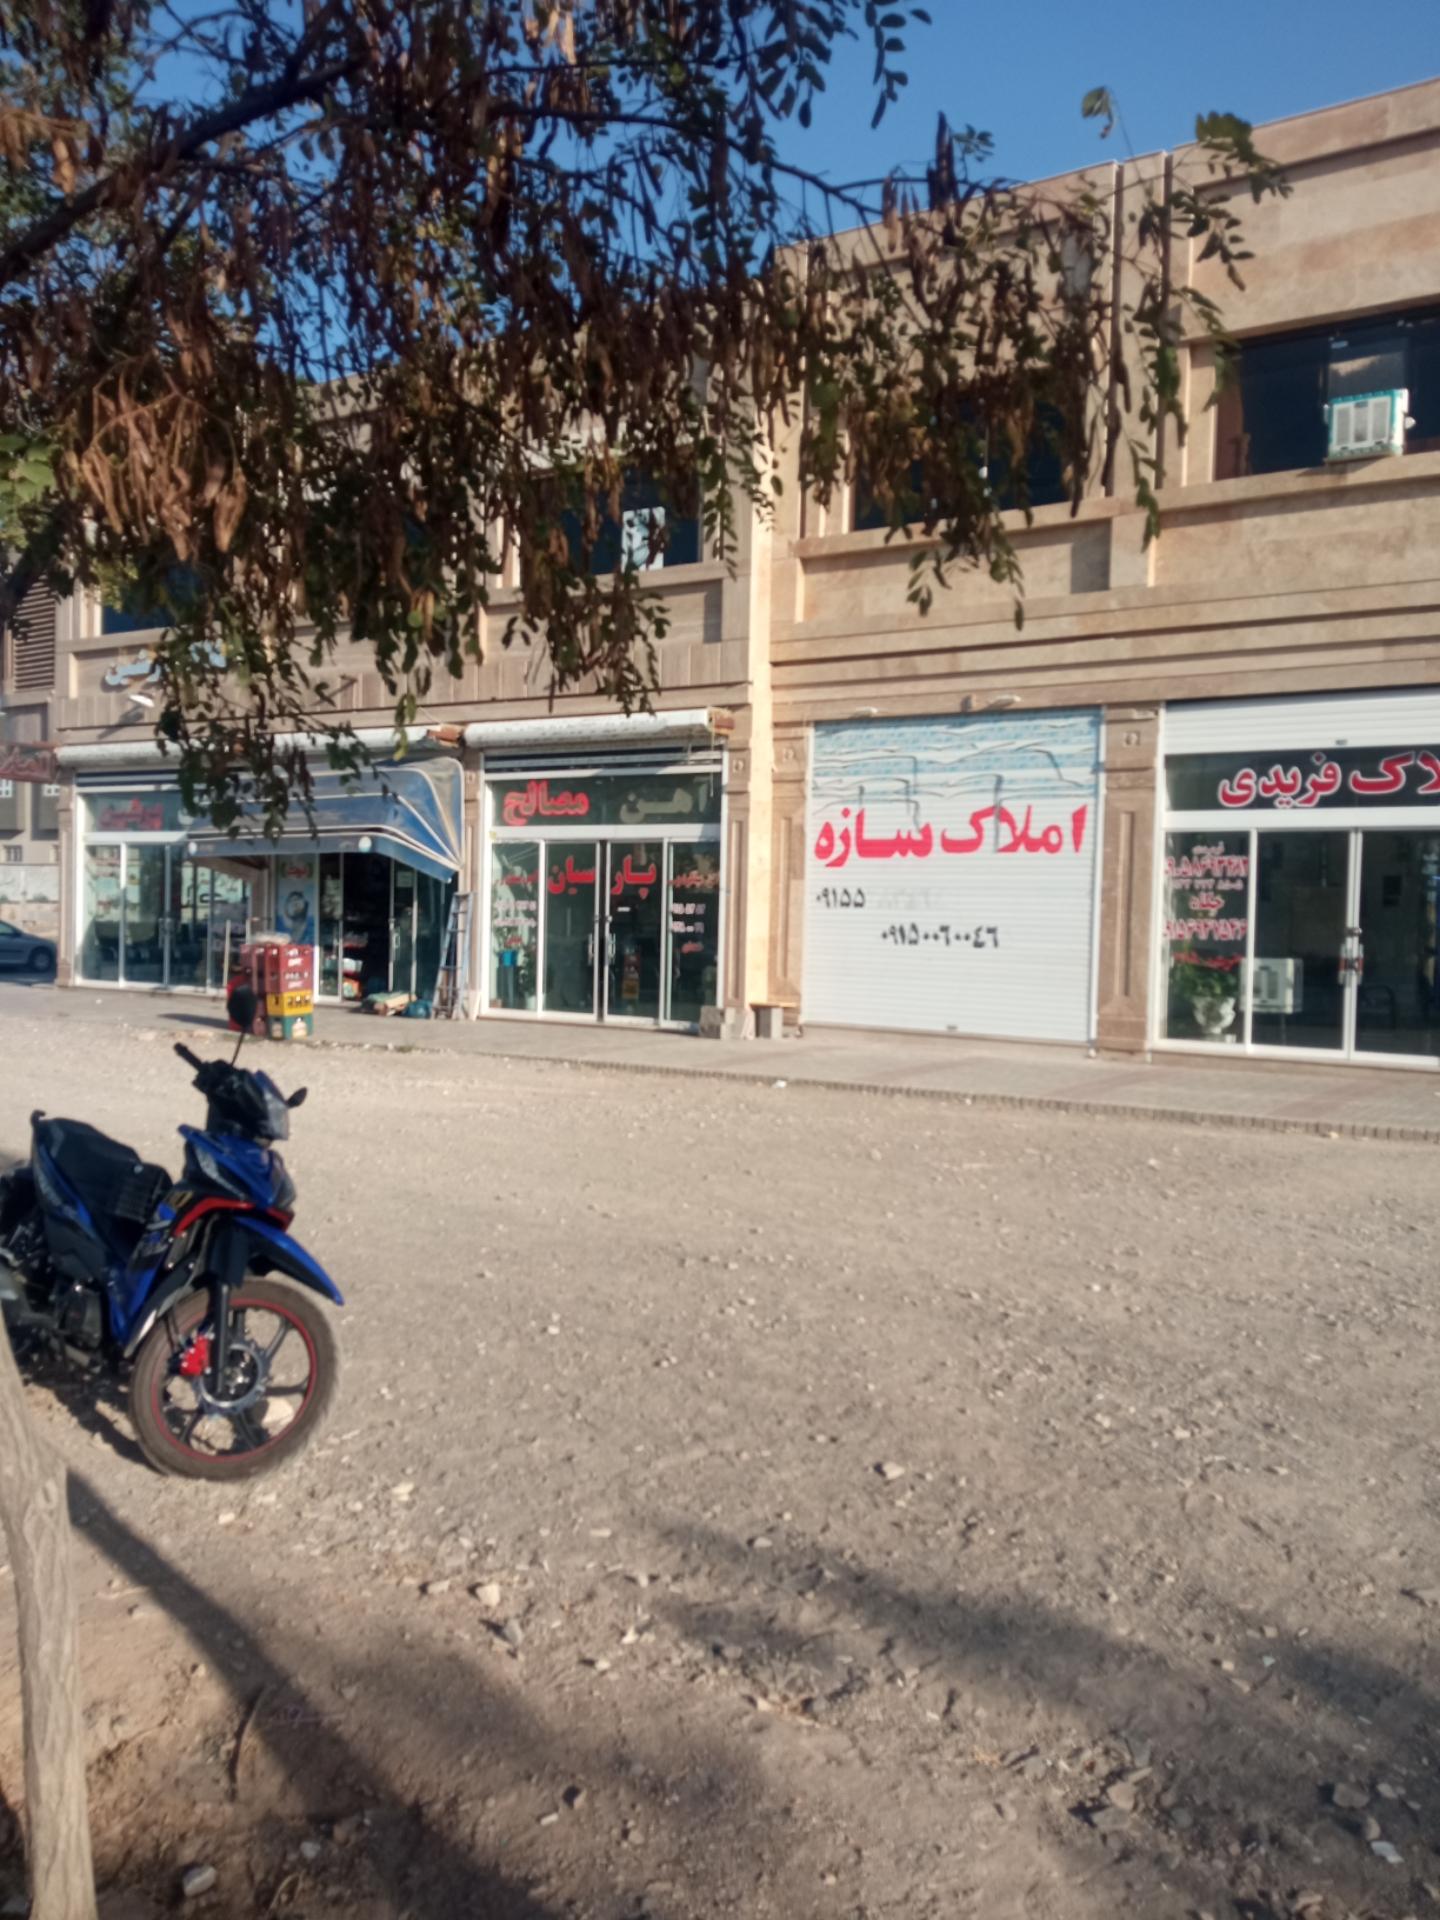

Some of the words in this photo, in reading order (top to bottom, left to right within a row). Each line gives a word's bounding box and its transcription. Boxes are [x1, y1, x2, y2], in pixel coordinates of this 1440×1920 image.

[503, 778, 590, 826] مصالح
[1219, 751, 1341, 808] فریدی
[814, 807, 933, 868] سازه
[940, 804, 1087, 854] املاک
